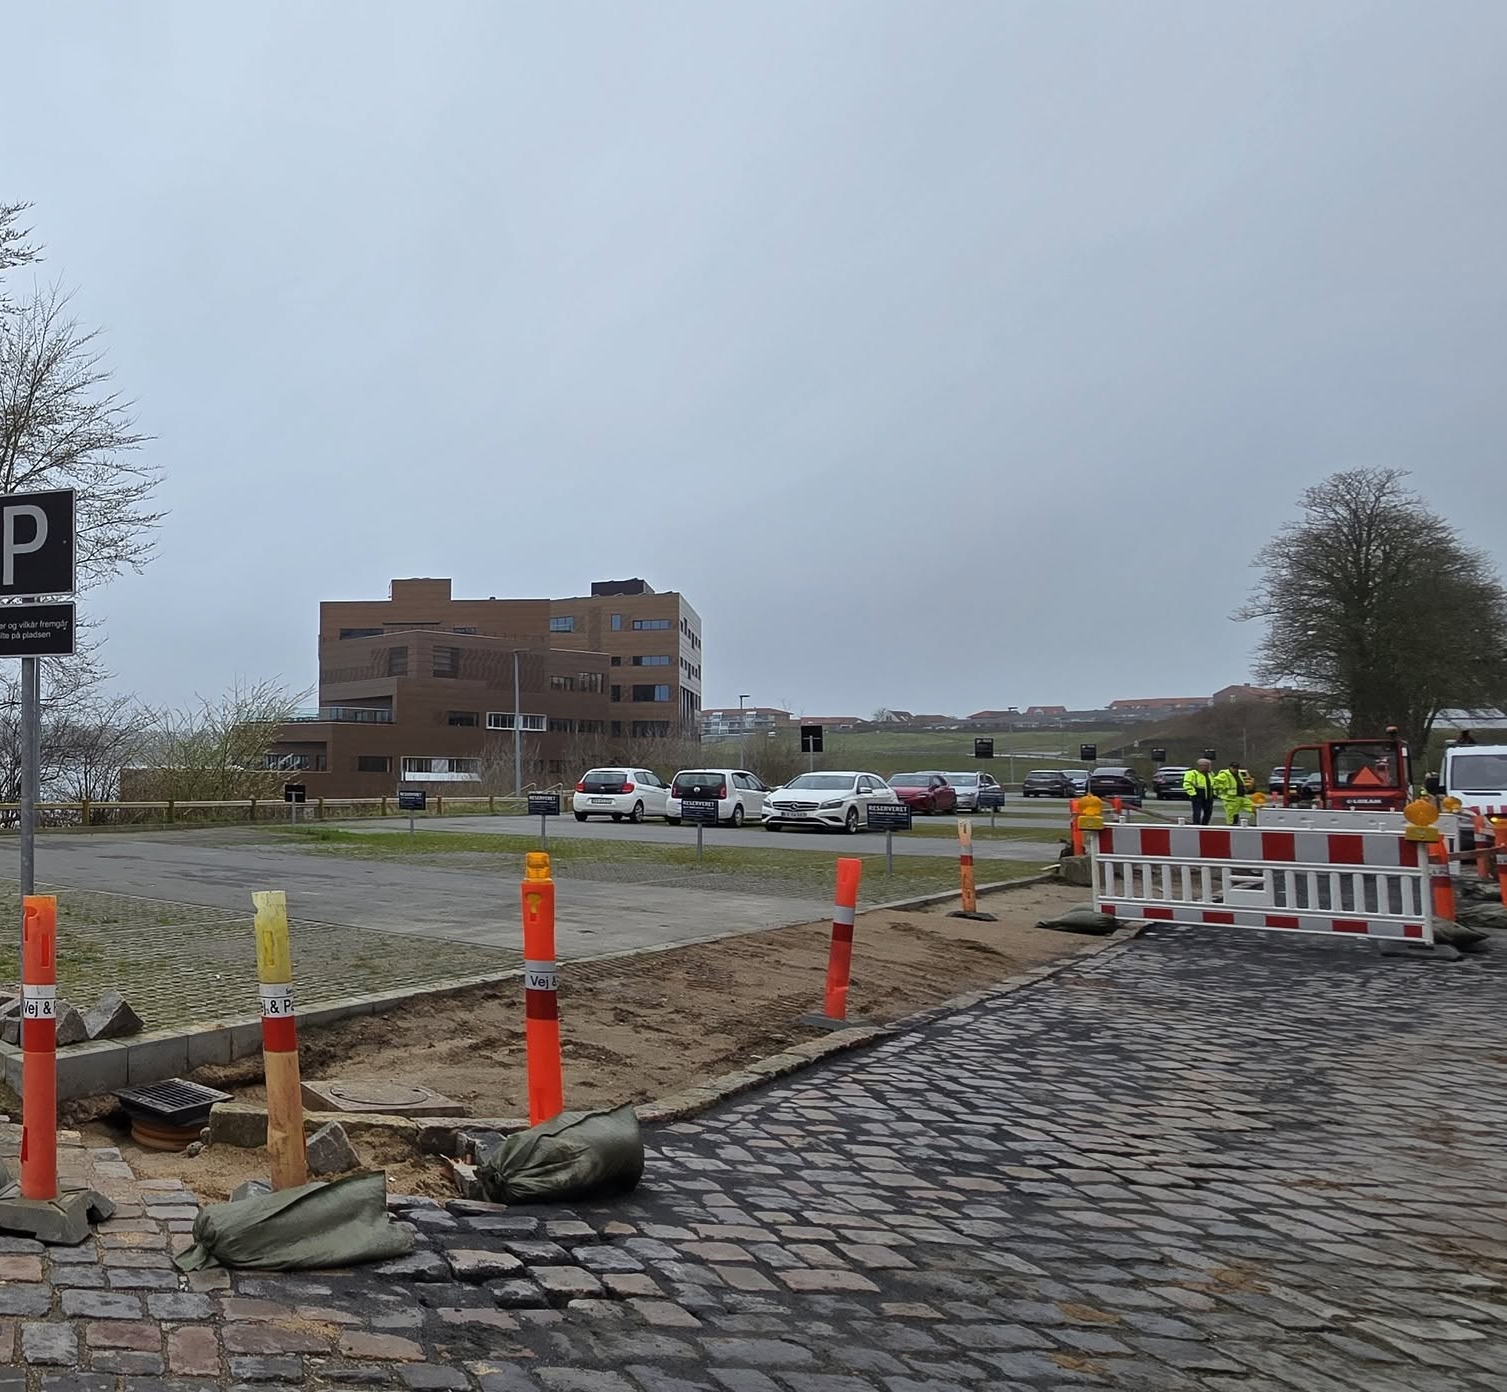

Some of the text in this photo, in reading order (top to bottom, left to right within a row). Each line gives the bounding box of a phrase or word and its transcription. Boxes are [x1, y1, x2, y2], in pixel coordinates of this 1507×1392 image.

[2, 504, 48, 586] P
[7, 623, 17, 631] og
[19, 620, 38, 629] vilkår
[39, 619, 69, 630] fremgår
[11, 631, 21, 640] på
[22, 631, 51, 640] pladsen
[530, 975, 549, 989] Vej
[43, 1001, 51, 1015] &
[270, 1000, 280, 1014] &
